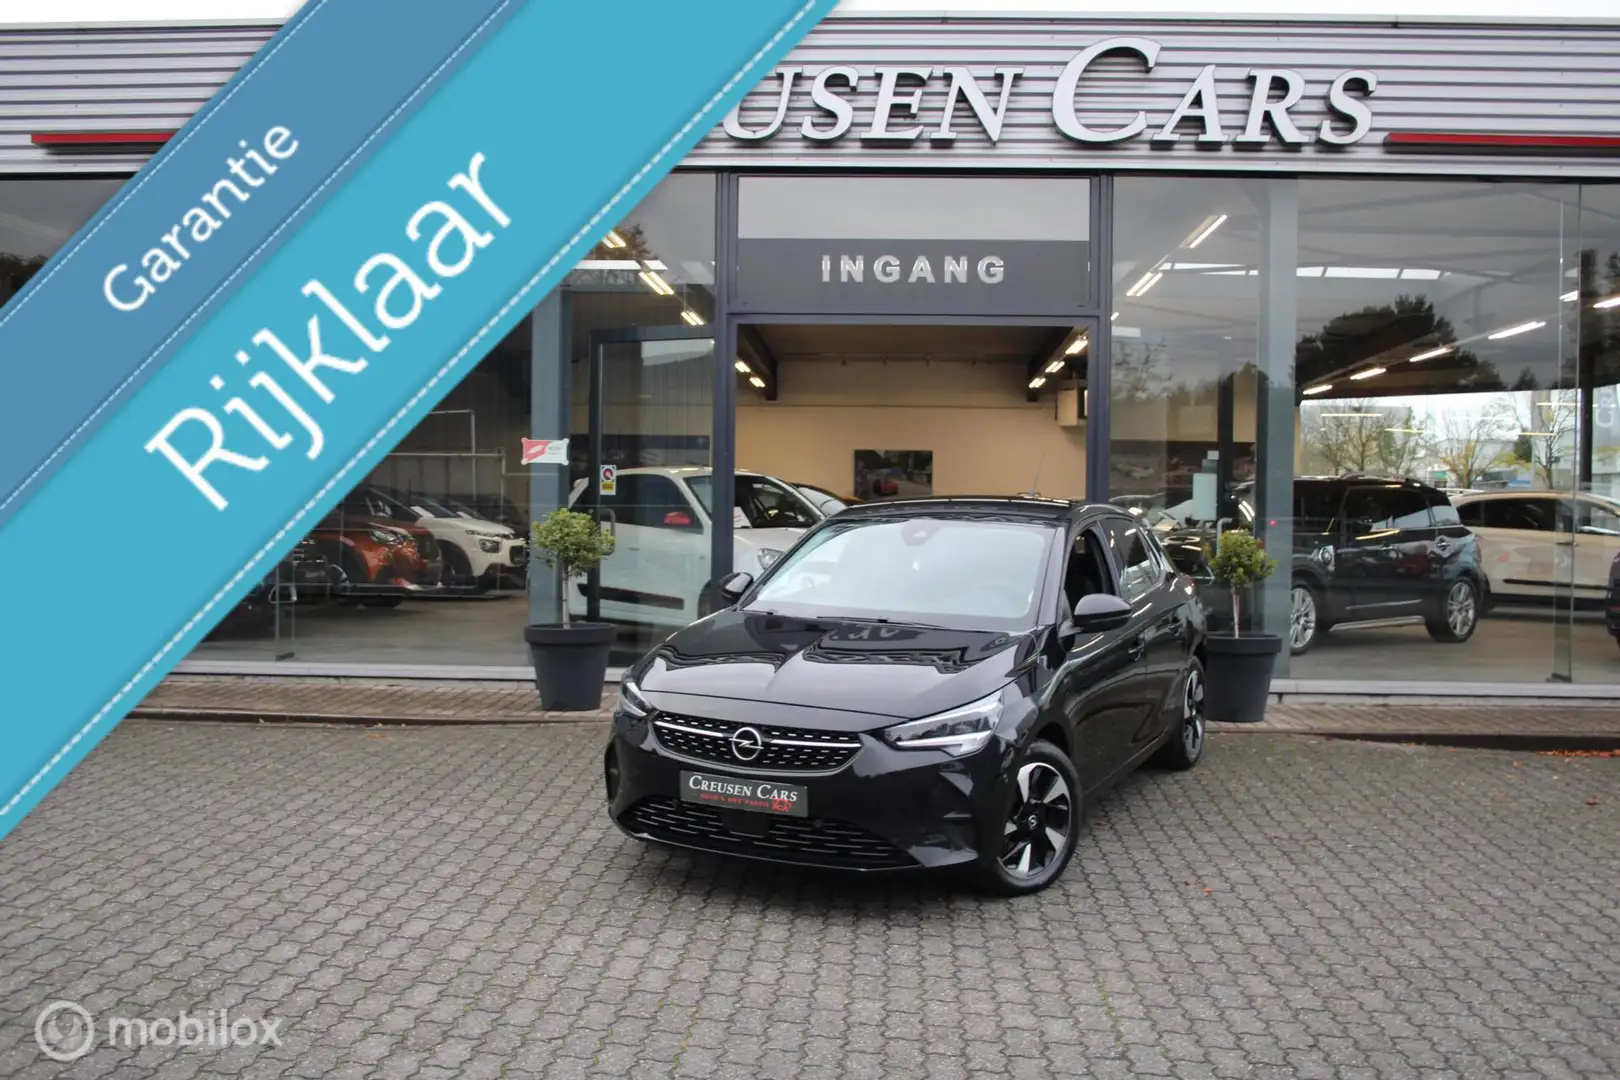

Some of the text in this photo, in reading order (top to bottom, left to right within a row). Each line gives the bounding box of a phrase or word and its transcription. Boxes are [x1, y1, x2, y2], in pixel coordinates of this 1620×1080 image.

[1052, 37, 1379, 146] CARS
[821, 254, 1005, 284] INGANG
[689, 775, 752, 796] CREUSEN
[757, 784, 798, 802] CARS
